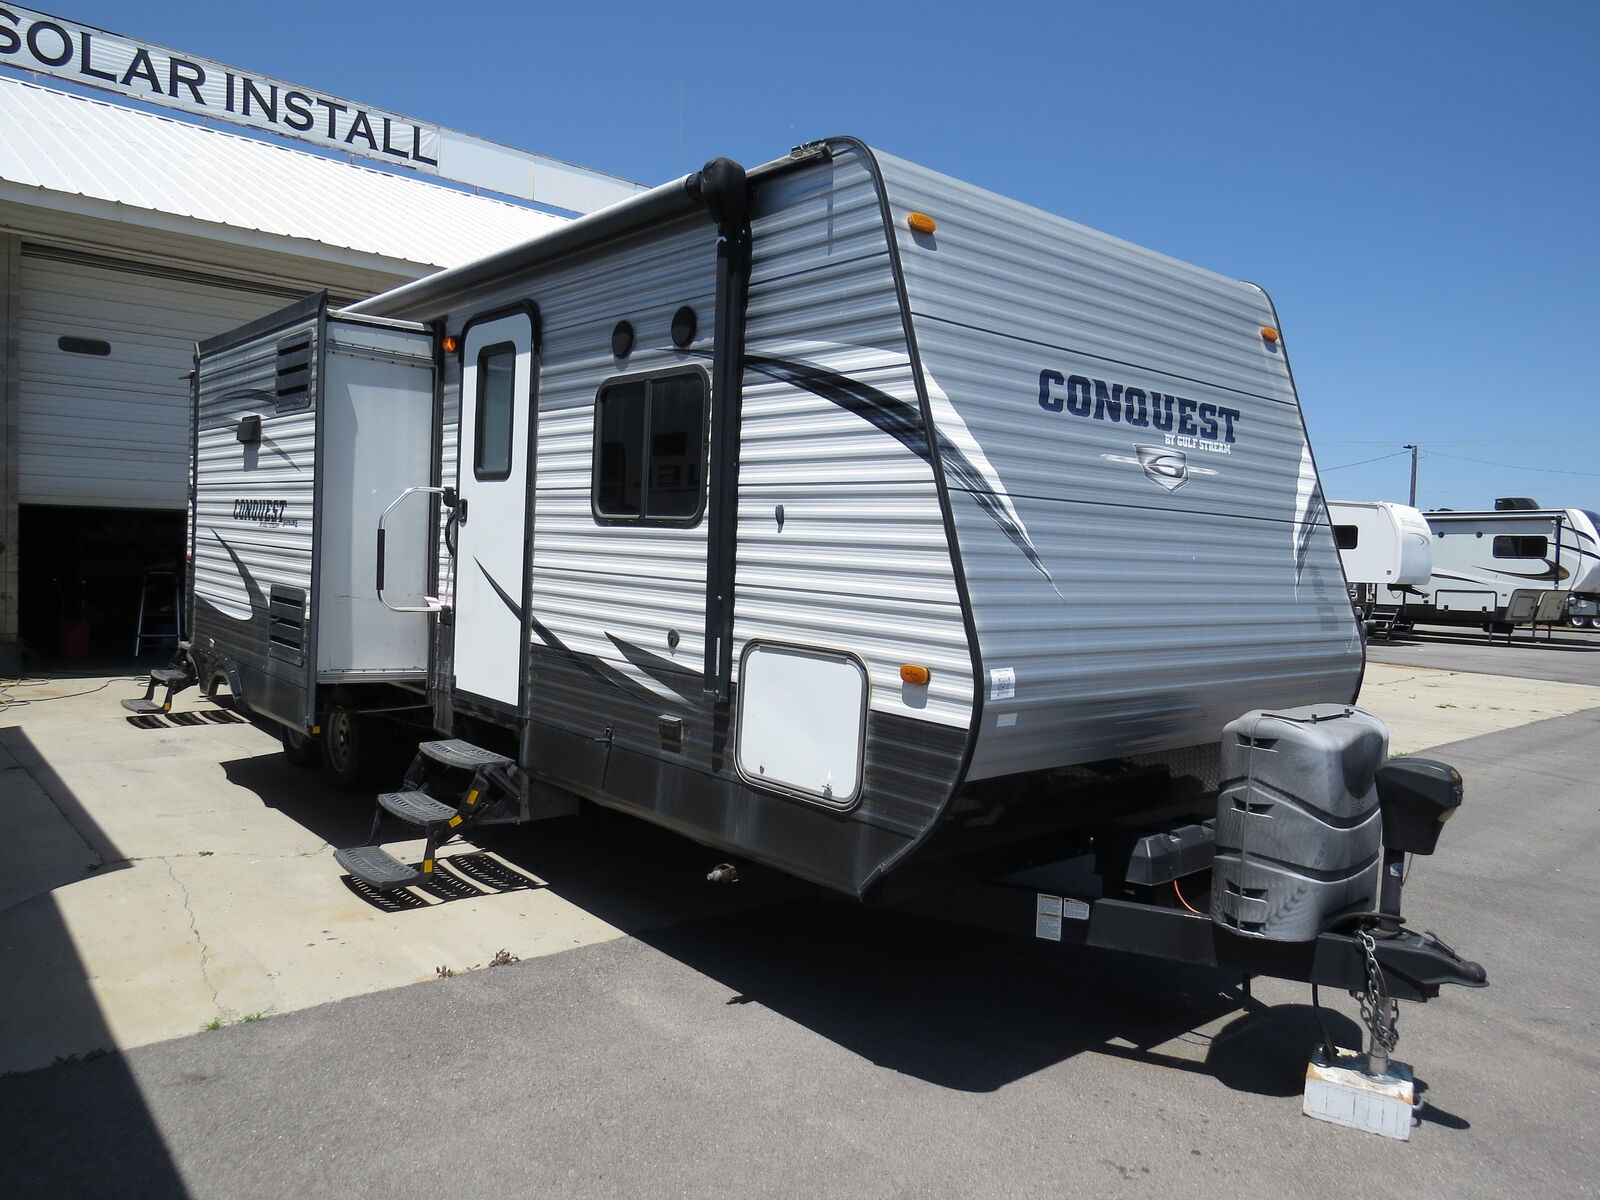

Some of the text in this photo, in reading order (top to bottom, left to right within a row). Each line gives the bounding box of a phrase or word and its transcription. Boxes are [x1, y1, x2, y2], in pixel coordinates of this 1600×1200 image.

[0, 7, 439, 166] SOLAR INSTALL
[1038, 369, 1240, 443] CONQUEST
[1164, 433, 1231, 454] BY GULF STREAM
[233, 499, 287, 522] CONQUEST
